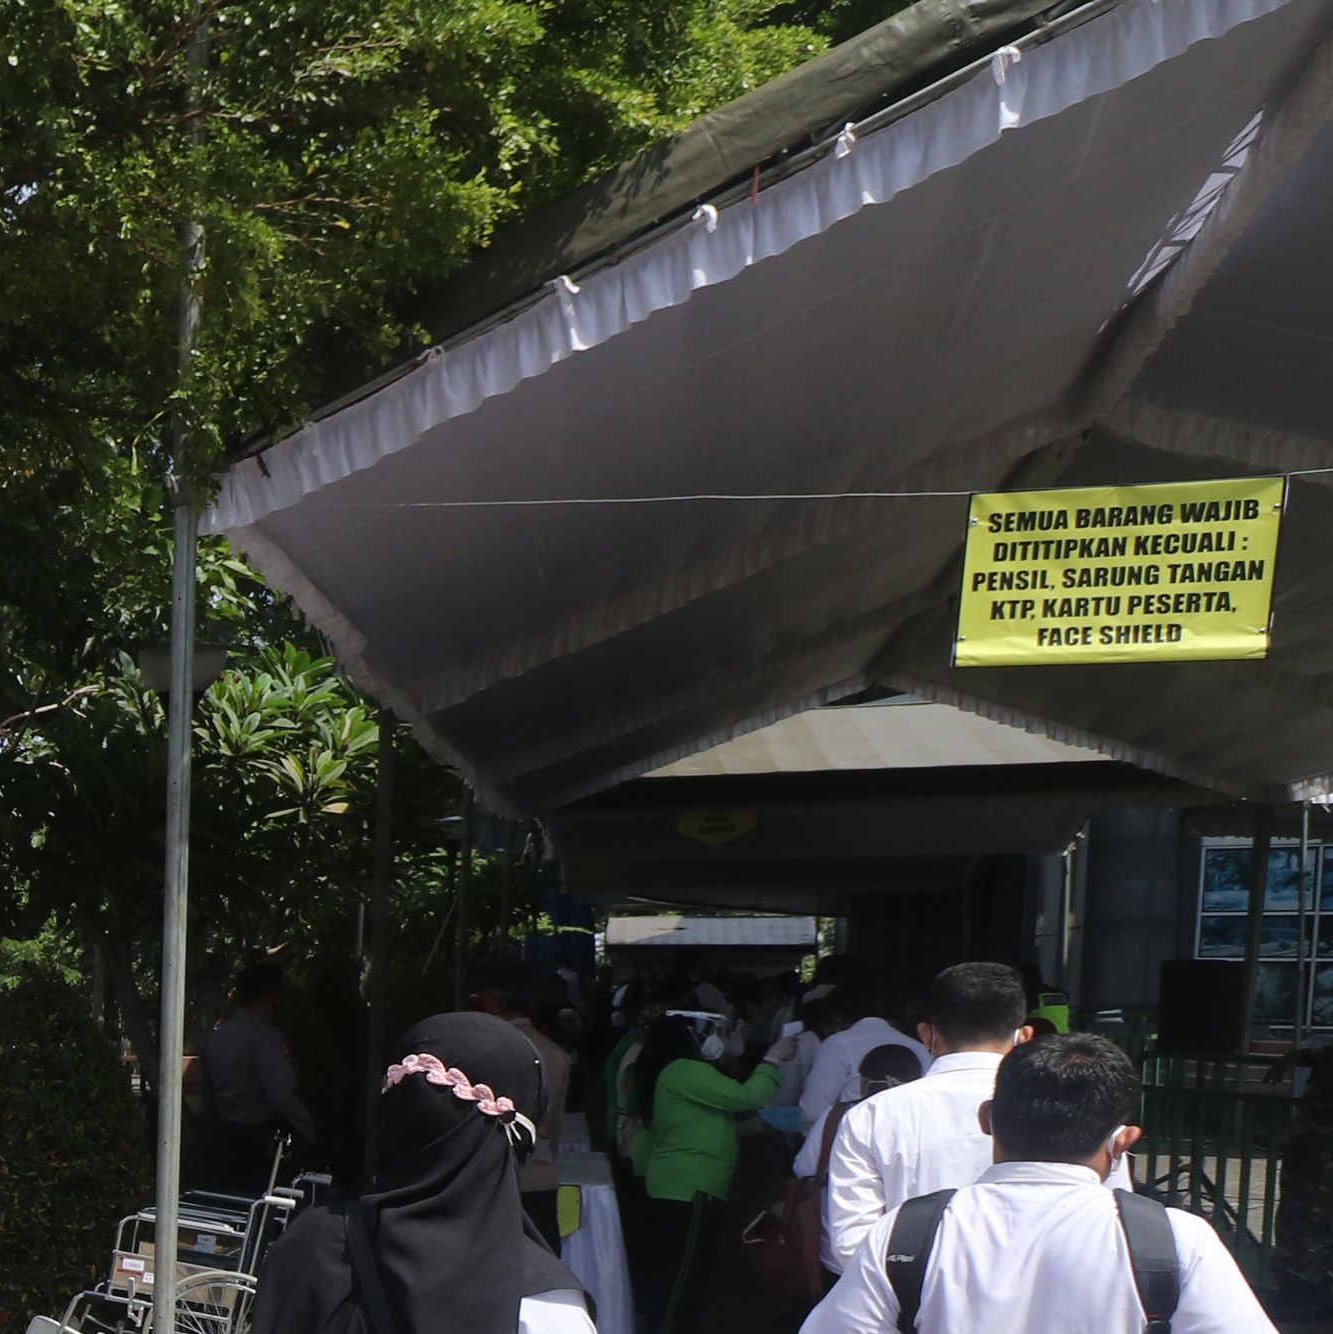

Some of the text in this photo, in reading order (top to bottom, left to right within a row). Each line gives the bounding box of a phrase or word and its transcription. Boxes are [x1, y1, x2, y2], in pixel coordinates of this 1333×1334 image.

[988, 499, 1260, 533] SEMUA BARANG WAJIB
[993, 536, 1127, 562] DITITIPKAN
[1133, 531, 1236, 558] KECUALI
[972, 560, 1265, 592] PENSIL, SARUNG TANGAN
[990, 591, 1237, 621] KTP, KARTU PESERTA,
[1037, 623, 1182, 647] FACE SHIELD
